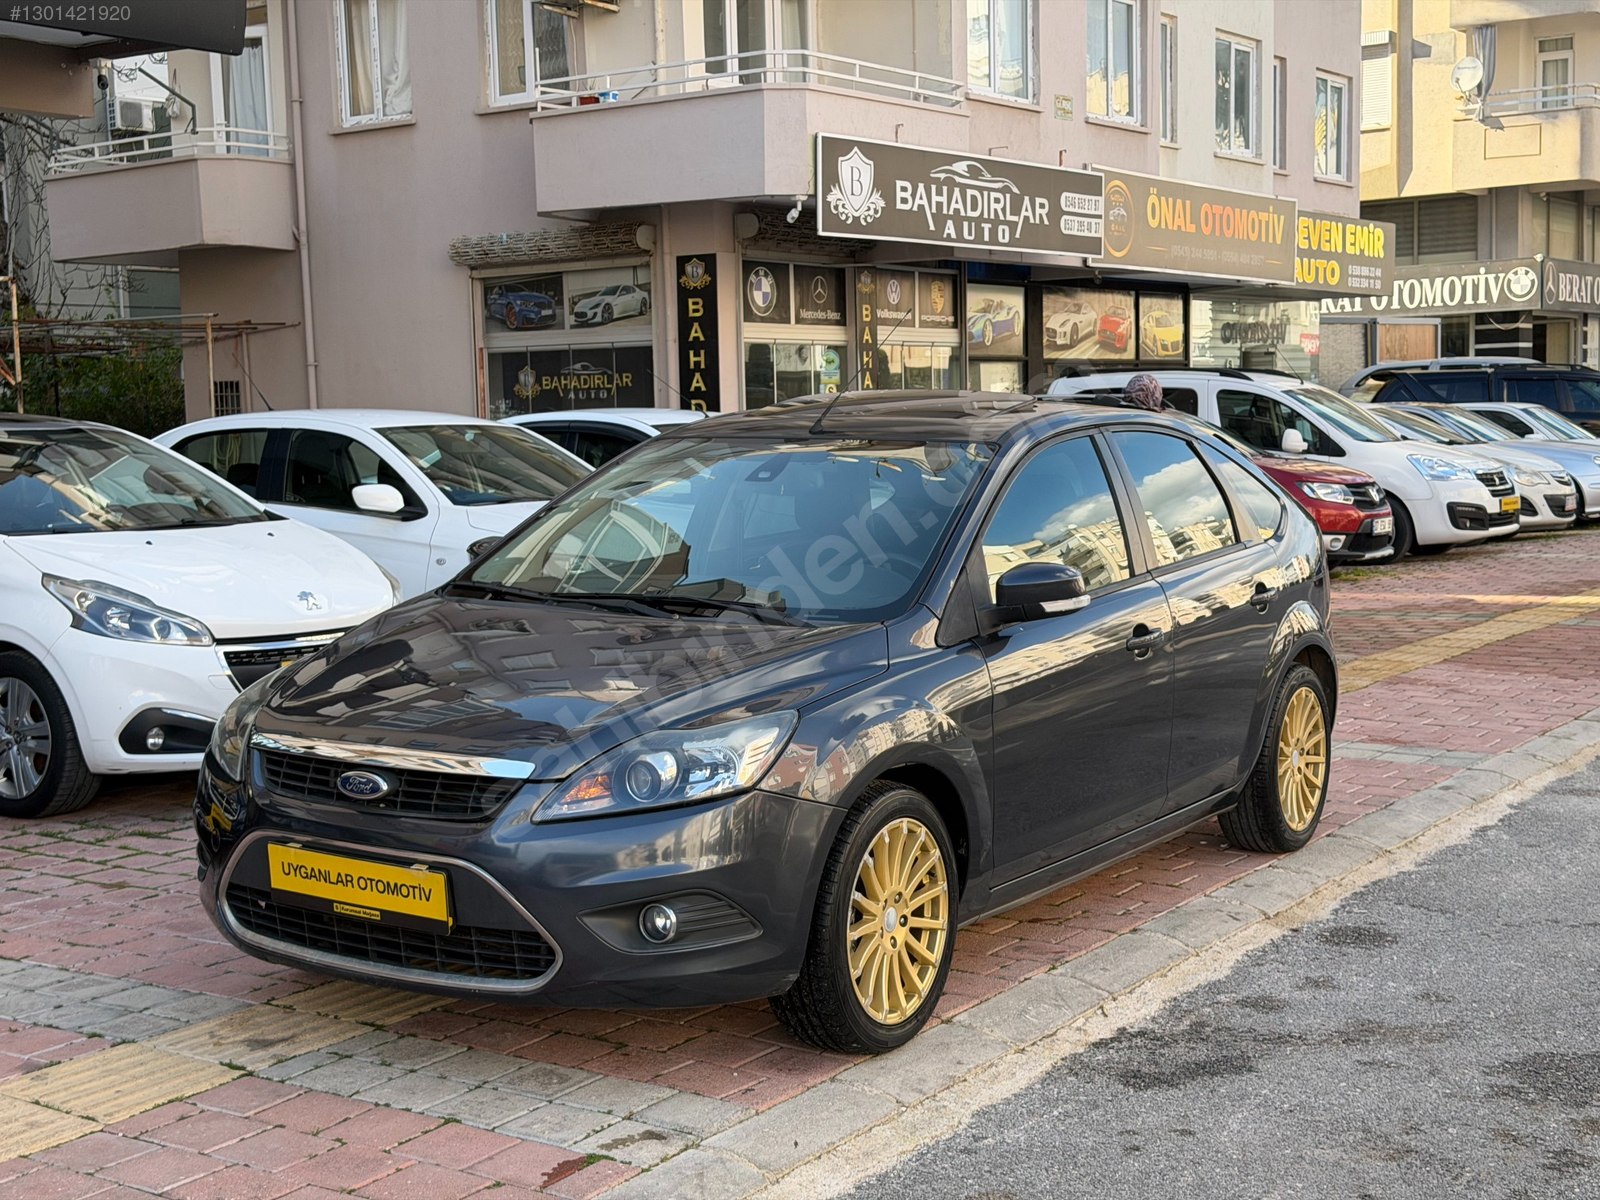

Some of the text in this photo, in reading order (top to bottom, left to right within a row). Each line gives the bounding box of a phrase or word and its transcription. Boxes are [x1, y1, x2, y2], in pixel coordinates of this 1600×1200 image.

[850, 165, 864, 196] B
[895, 180, 1050, 238] BAHADIRLAR
[1146, 187, 1285, 245] ÖNAL OTOMOTİV
[942, 218, 1010, 244] AUTO
[690, 265, 699, 279] B
[1296, 257, 1341, 286] AUTO
[1558, 272, 1594, 304] BERAT
[800, 308, 842, 320] Mercedes-Benz
[542, 373, 632, 397] BAHADIRLAR
[568, 389, 608, 400] AUTO
[345, 776, 373, 794] Ford
[281, 860, 433, 902] UYGANLAR OTOMOTİV
